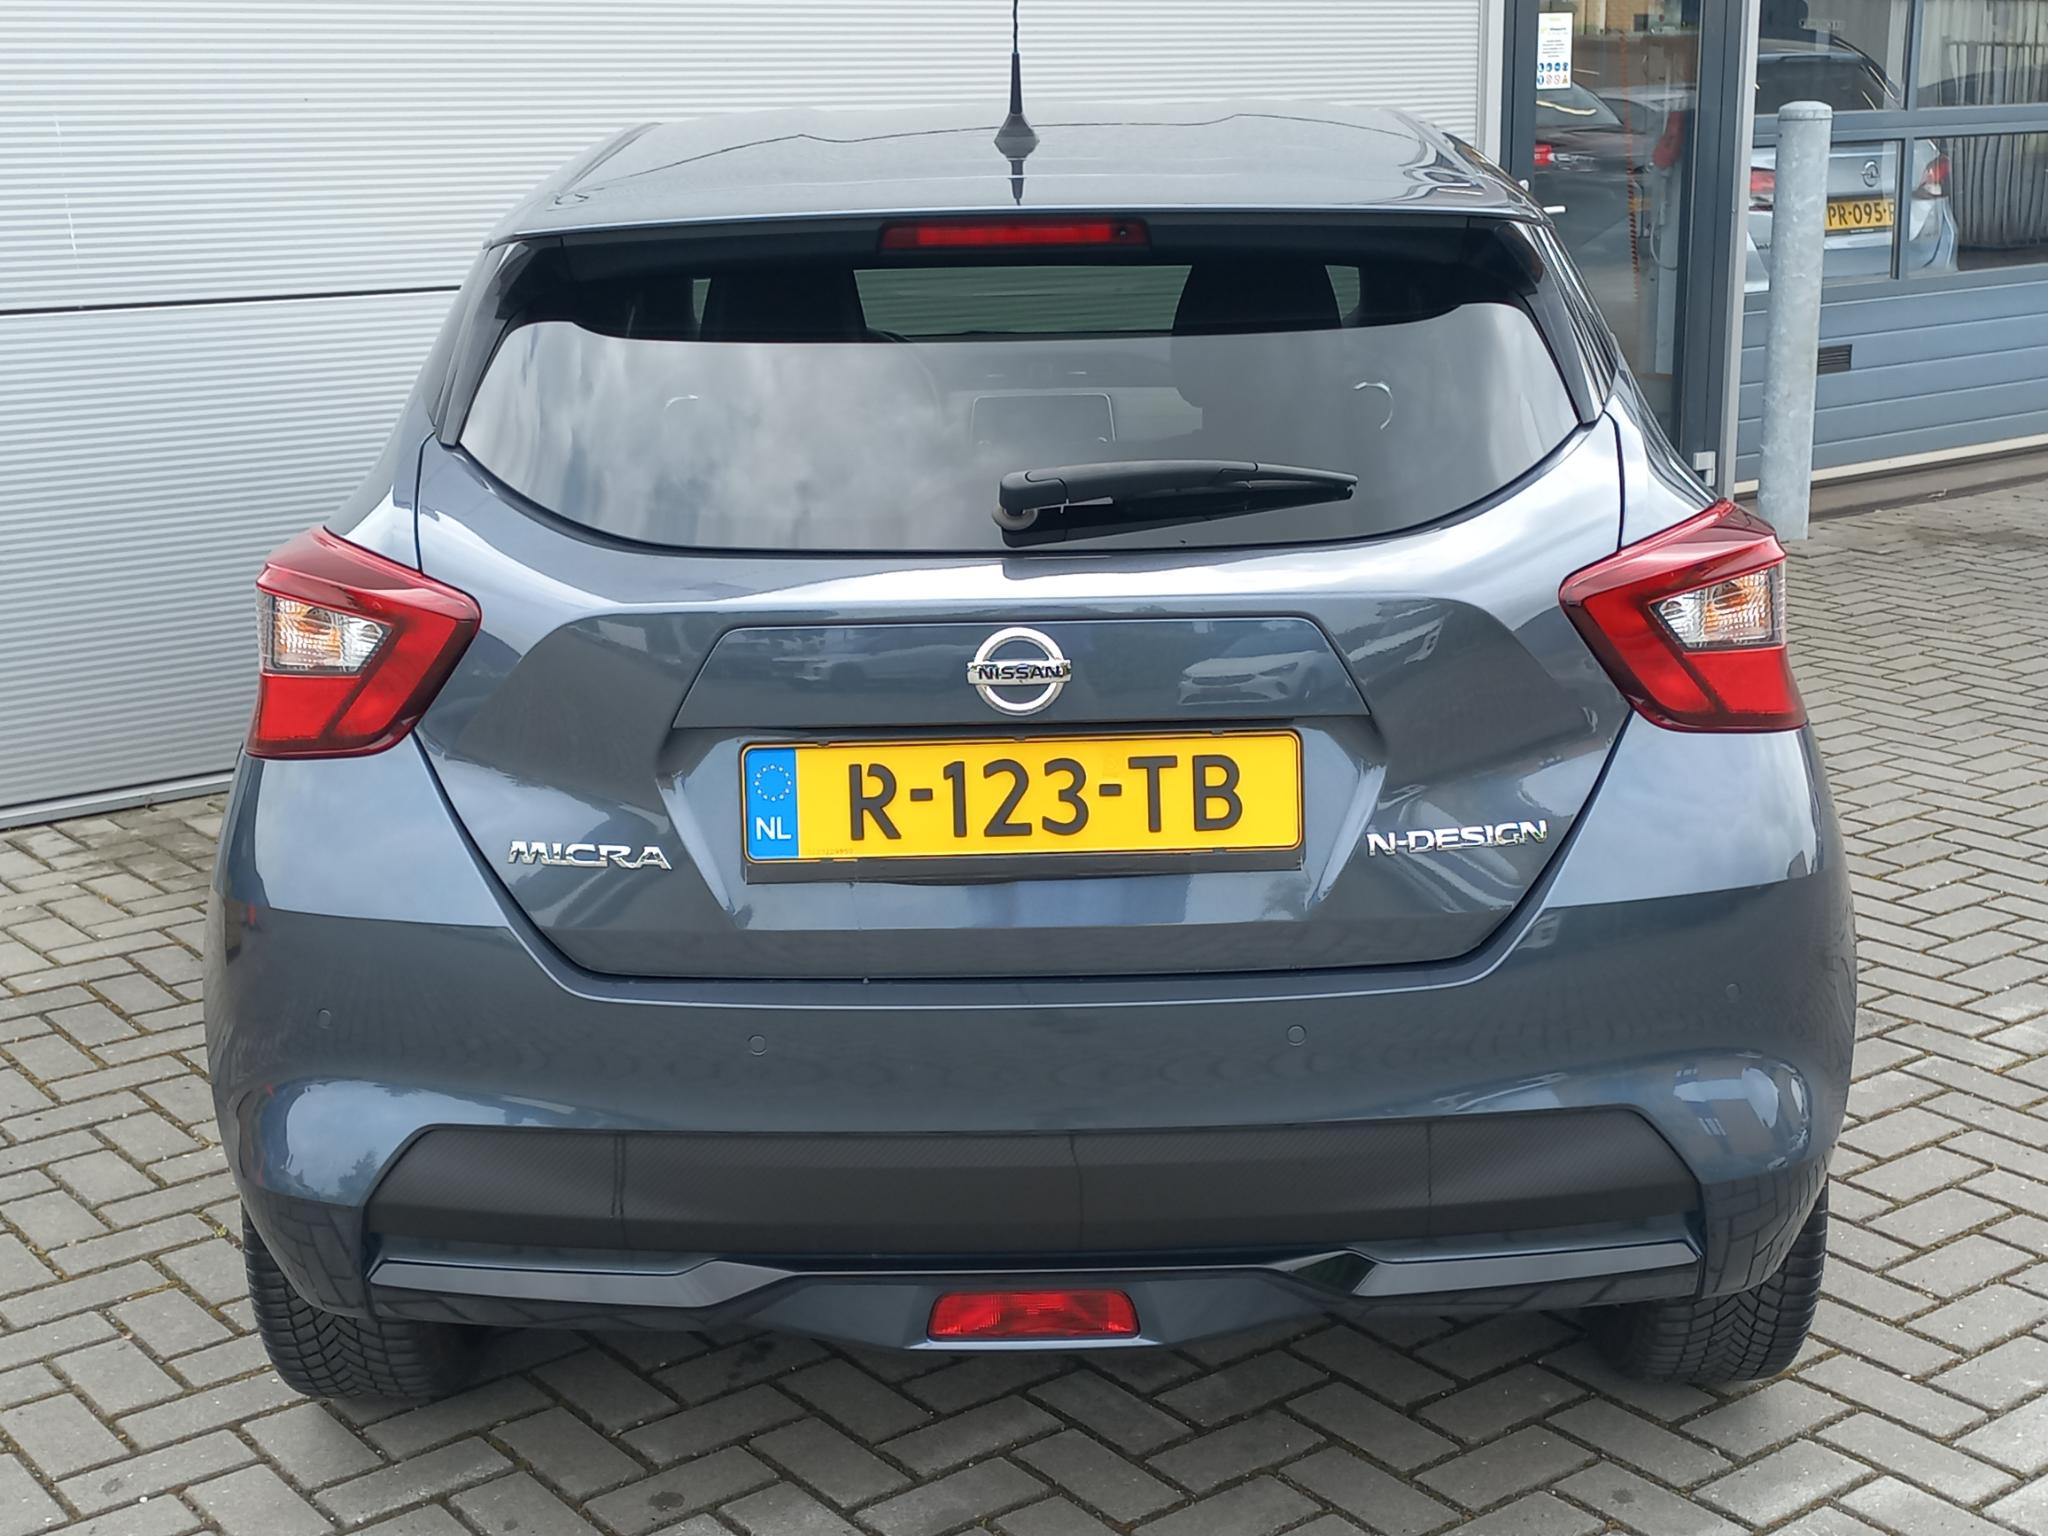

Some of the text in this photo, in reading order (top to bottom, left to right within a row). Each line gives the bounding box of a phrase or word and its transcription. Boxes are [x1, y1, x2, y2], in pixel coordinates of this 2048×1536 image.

[978, 664, 1064, 680] NISSAN
[848, 754, 1244, 841] R-123-TB
[755, 816, 792, 841] NL
[1366, 819, 1548, 857] N-DESIGN
[507, 840, 672, 870] MICRA
